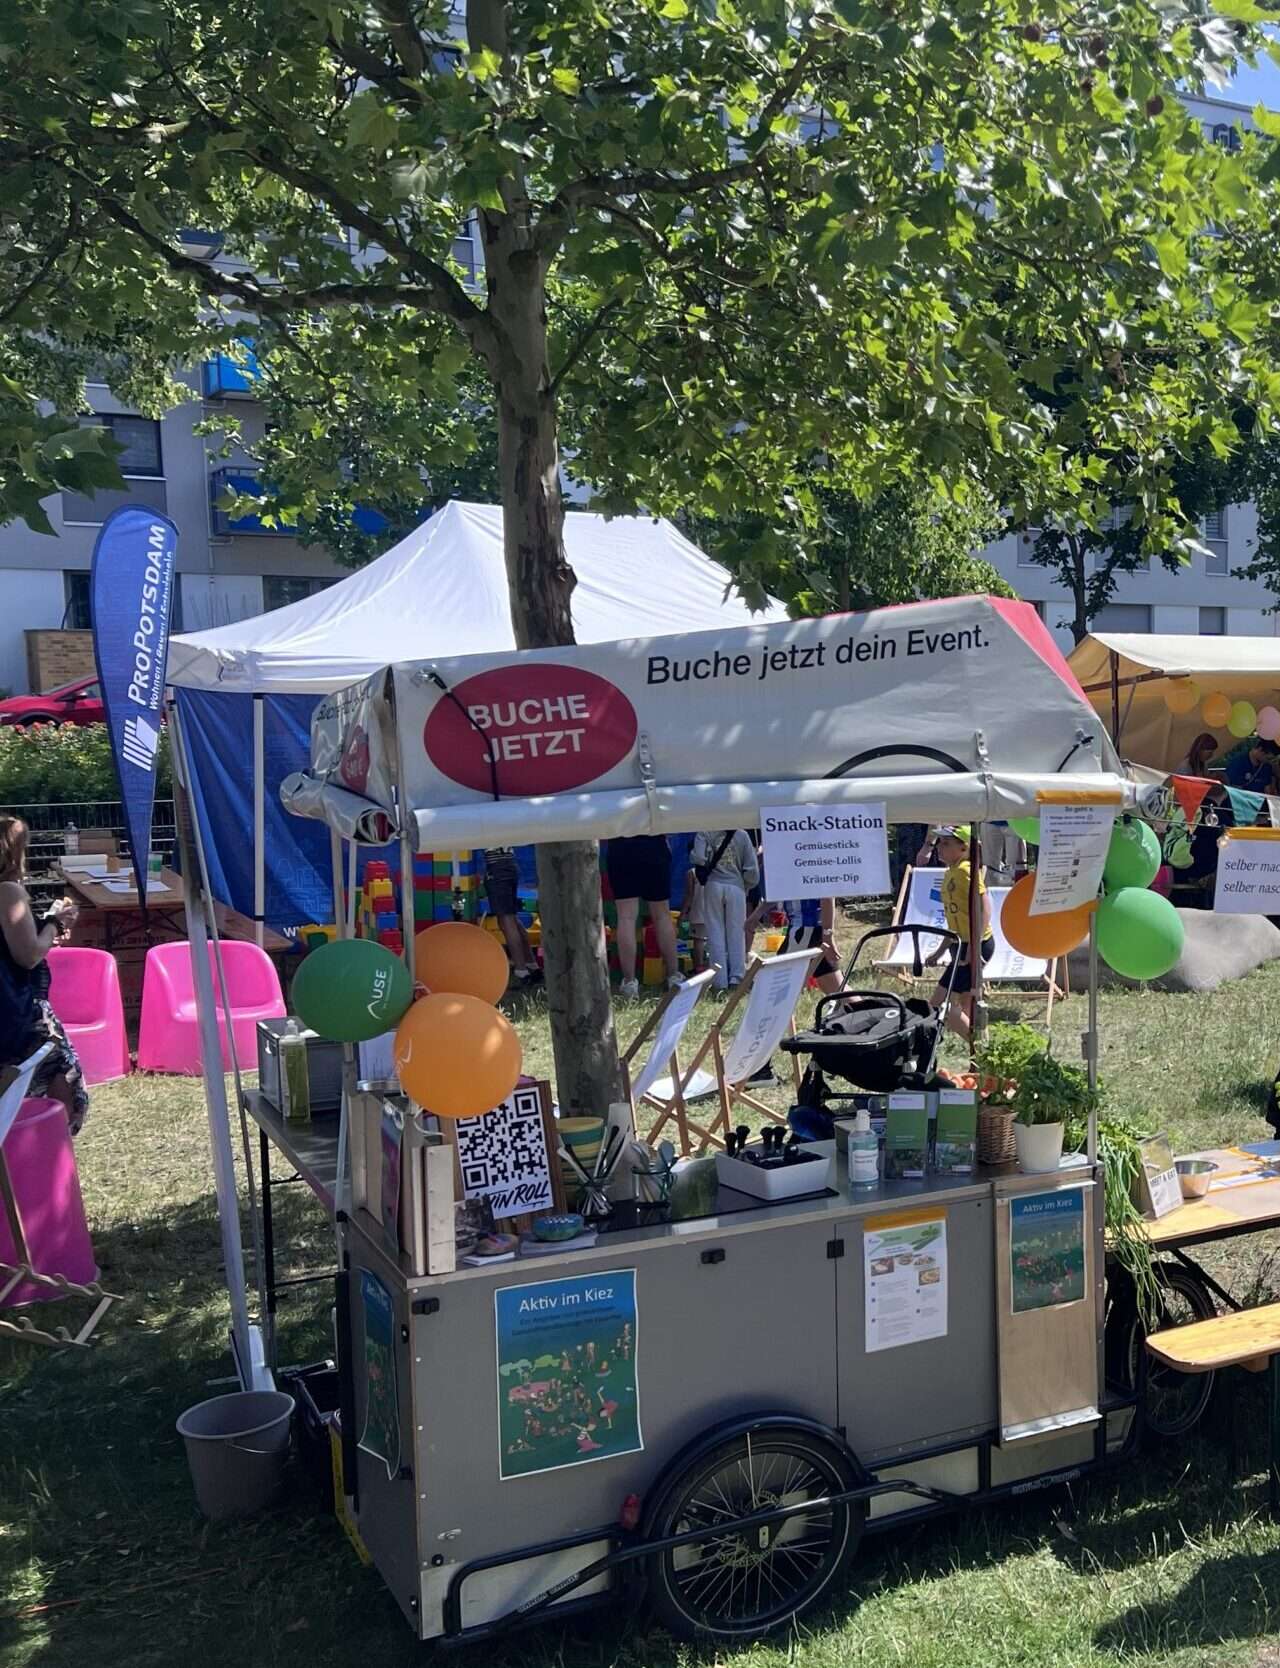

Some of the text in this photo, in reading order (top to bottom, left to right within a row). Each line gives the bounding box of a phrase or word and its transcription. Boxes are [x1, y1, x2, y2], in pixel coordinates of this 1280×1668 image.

[647, 624, 990, 684] Buche jetzt dein Event.
[149, 667, 162, 710] Wohnen
[467, 694, 590, 730] BUCHE
[483, 728, 585, 763] JETZT
[765, 814, 884, 832] Snack-Station
[794, 839, 860, 851] Gemüsesticks
[794, 855, 862, 867] Gemüse-Lollis
[1224, 858, 1258, 872] selber
[802, 873, 860, 884] Kräuter-Dip
[1223, 880, 1256, 893] selber
[371, 968, 387, 999] USE
[519, 1288, 614, 1312] Aktiv im Kiez
